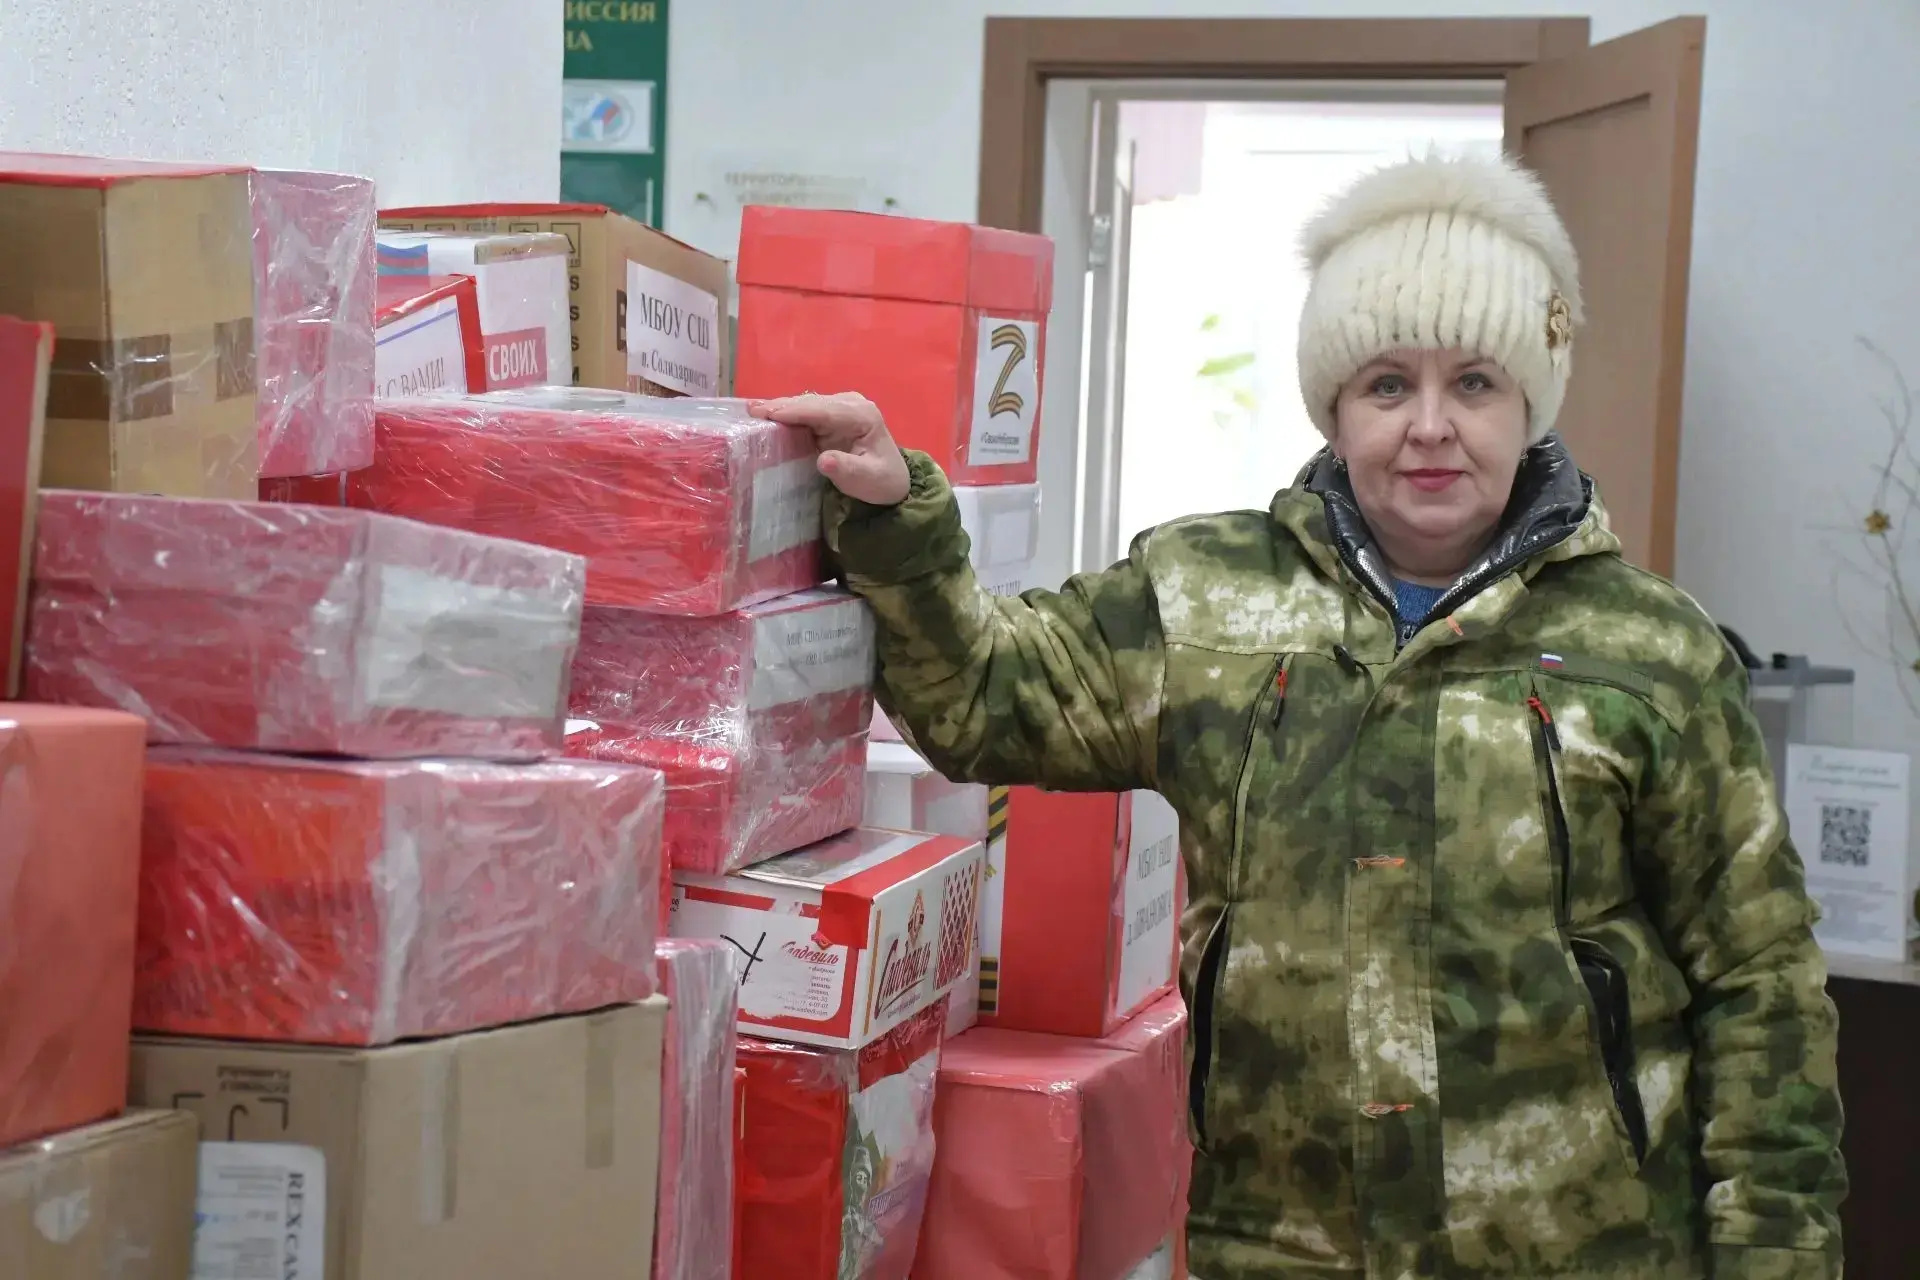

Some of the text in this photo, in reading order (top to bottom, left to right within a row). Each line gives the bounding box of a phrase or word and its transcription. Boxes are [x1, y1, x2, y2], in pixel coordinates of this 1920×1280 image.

[641, 292, 684, 339] МБОУ
[686, 313, 710, 351] СШ
[400, 356, 446, 398] ВАМИ!
[489, 339, 539, 382] СВОИХ
[782, 941, 840, 965] Сладевиль
[873, 938, 931, 1020] Сладевиль
